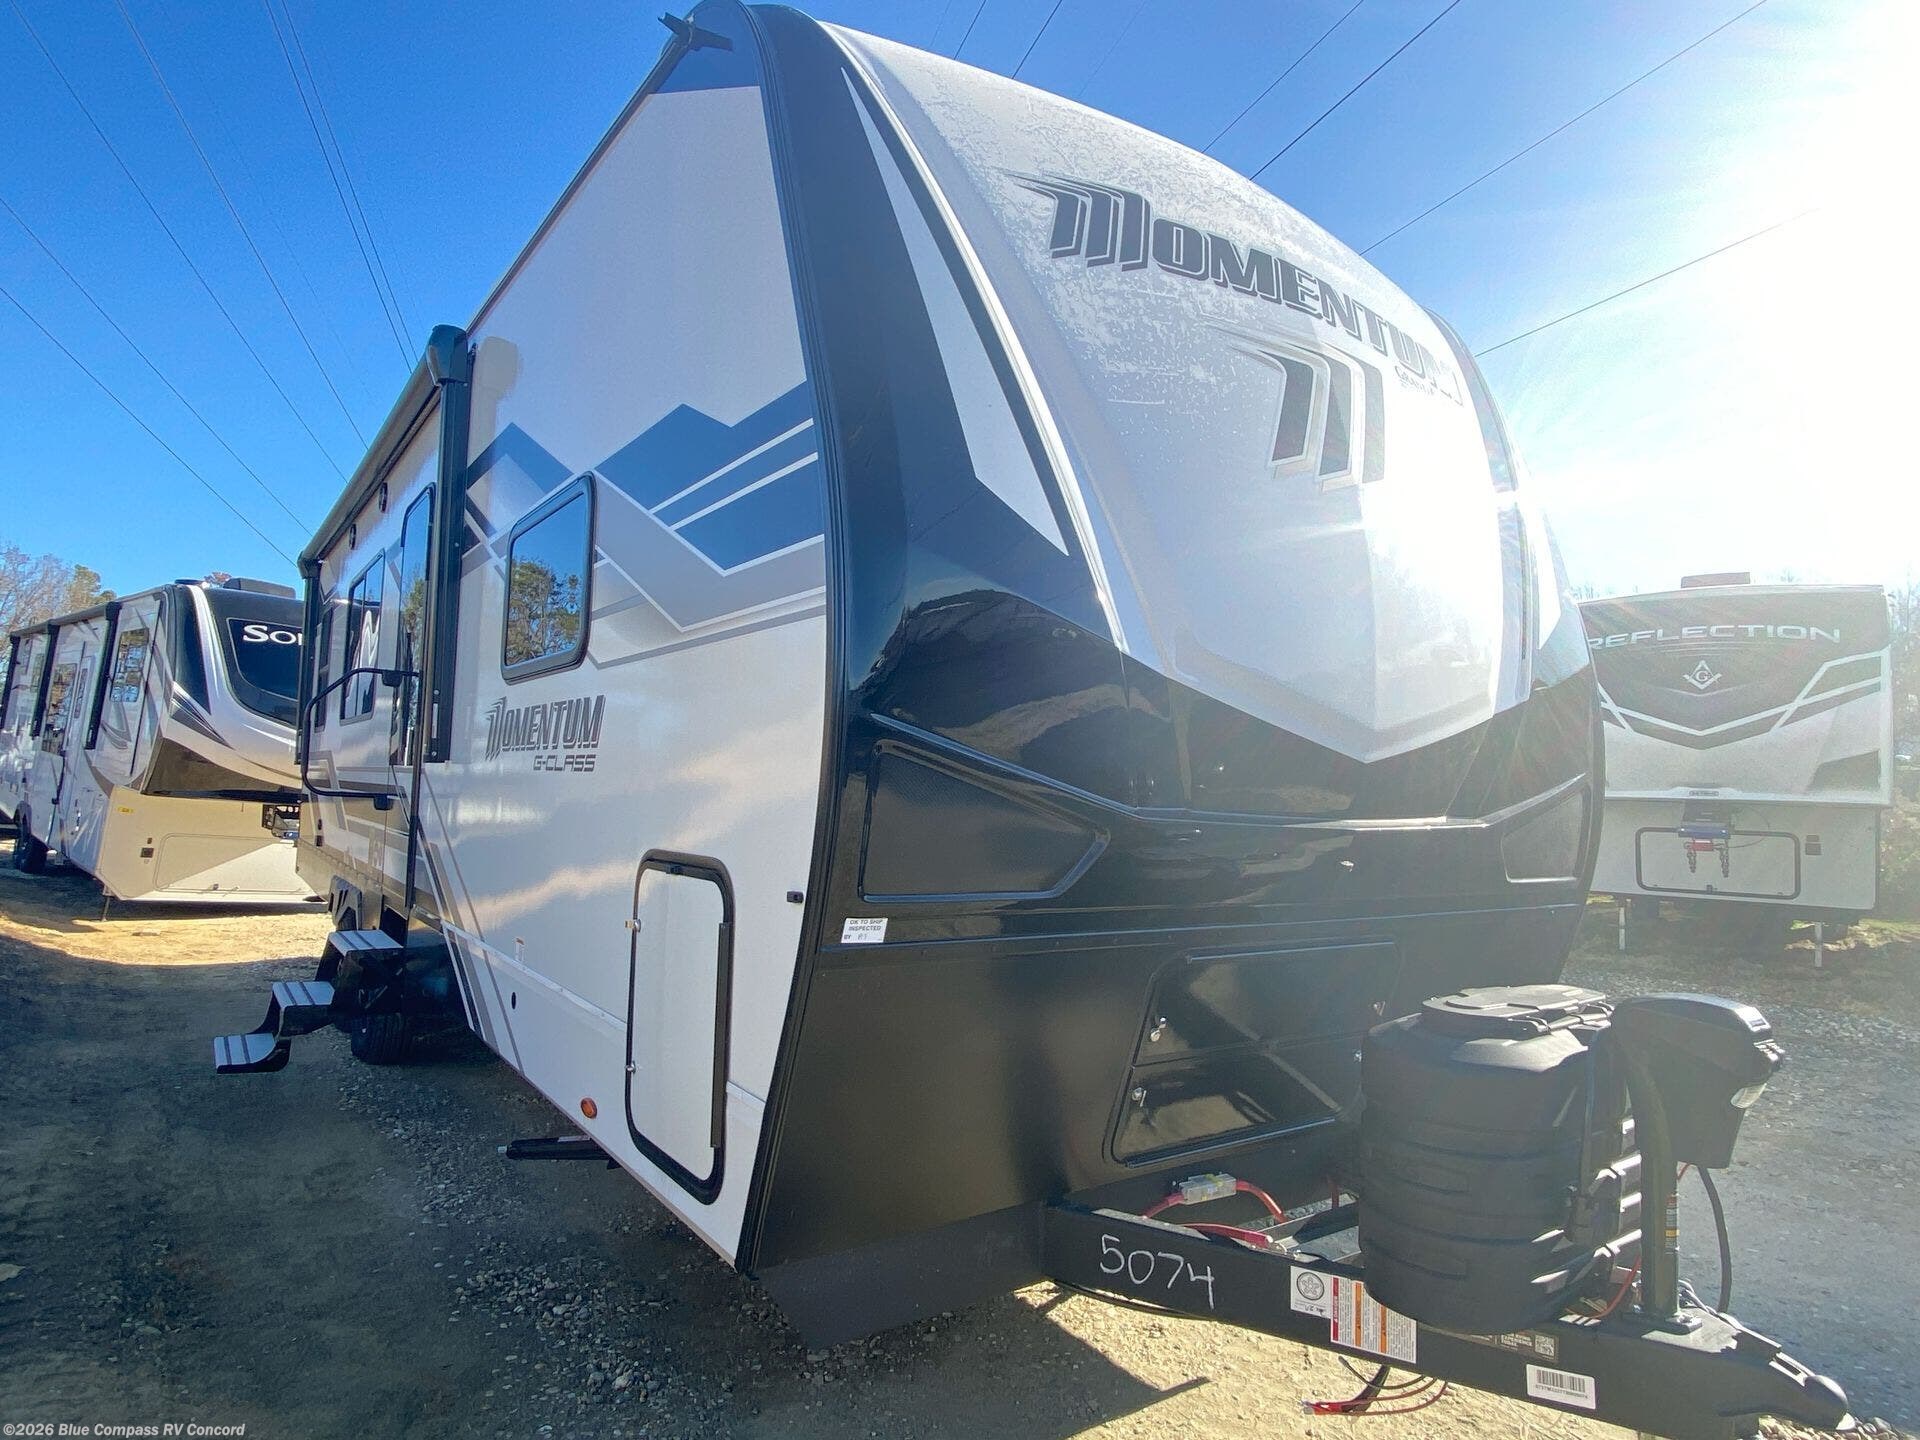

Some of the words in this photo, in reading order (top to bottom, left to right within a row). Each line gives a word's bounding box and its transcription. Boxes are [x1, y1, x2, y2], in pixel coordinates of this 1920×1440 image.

[1587, 623, 1841, 650] REFLECTION
[485, 694, 606, 761] MOMENTUM
[533, 754, 597, 772] G-CLASS
[1100, 1233, 1215, 1310] 5074
